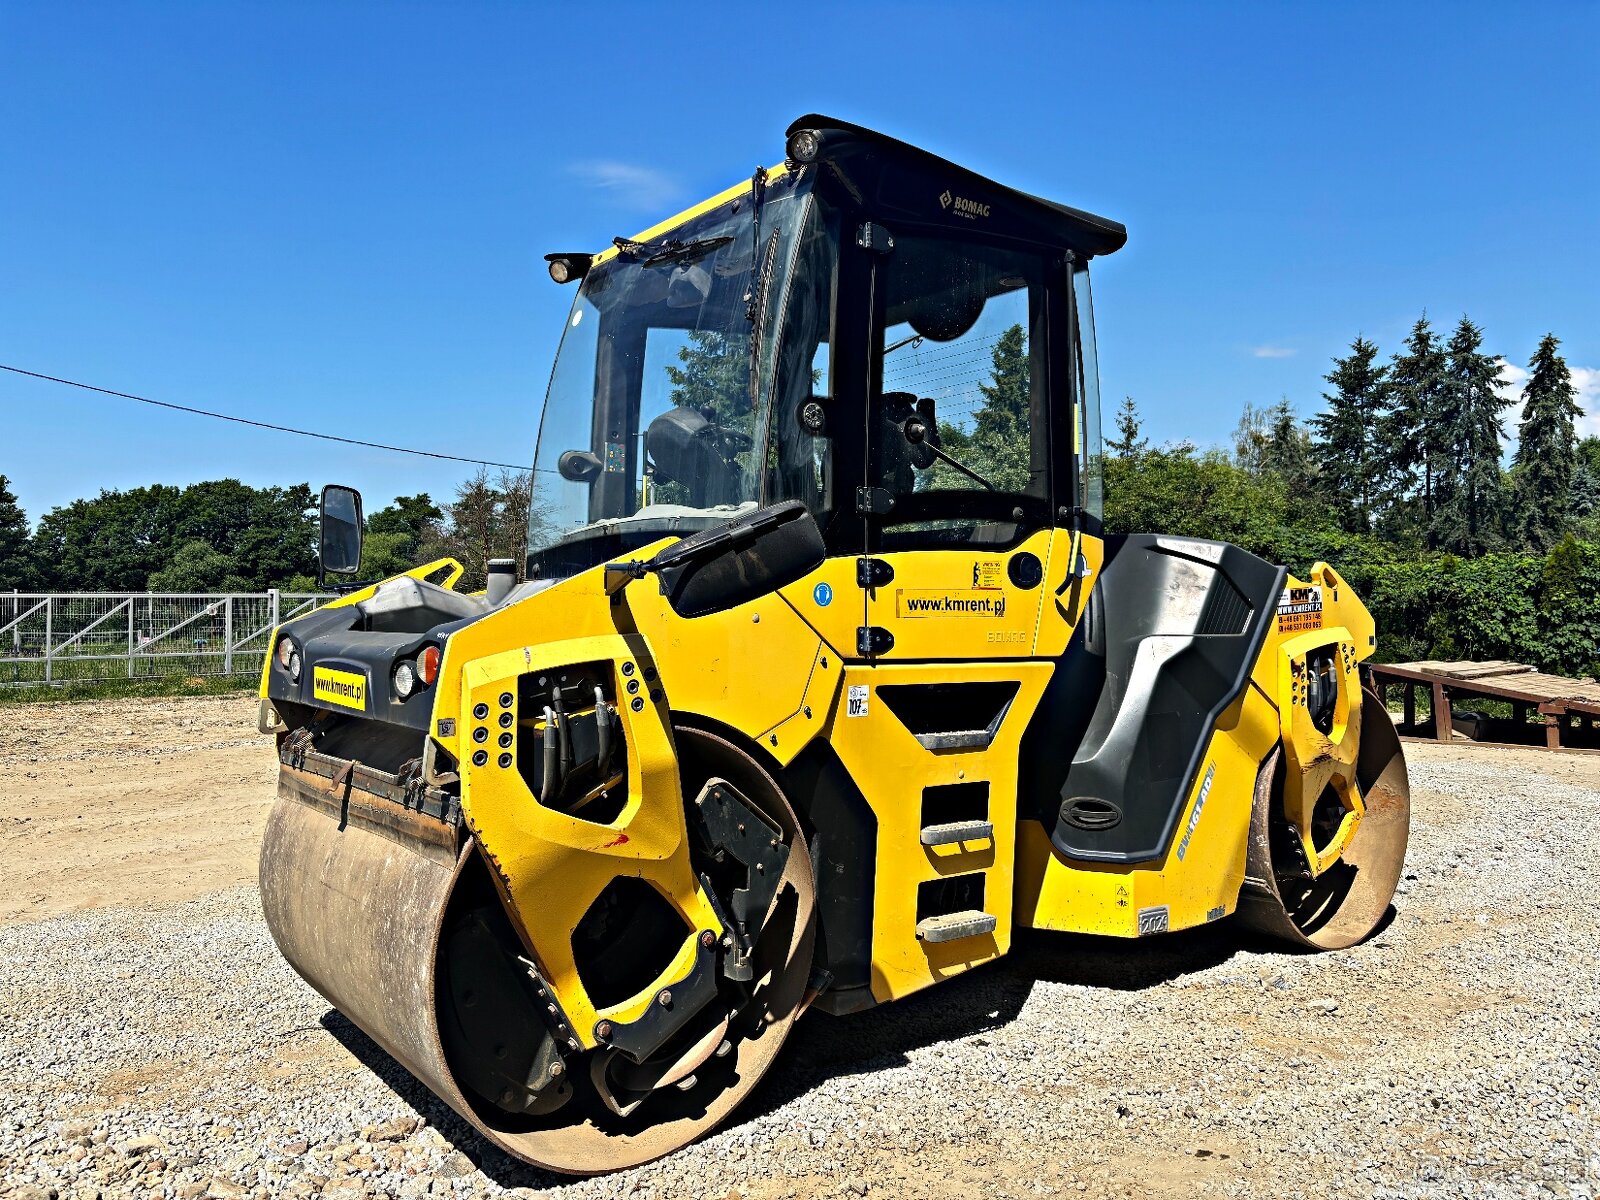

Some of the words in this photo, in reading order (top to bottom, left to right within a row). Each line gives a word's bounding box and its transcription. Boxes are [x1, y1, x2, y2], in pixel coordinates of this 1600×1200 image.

[954, 196, 991, 217] BOMAG
[907, 596, 1005, 617] www.kmrent.pl
[315, 677, 364, 704] www.kmrent.pl
[849, 699, 861, 714] 107
